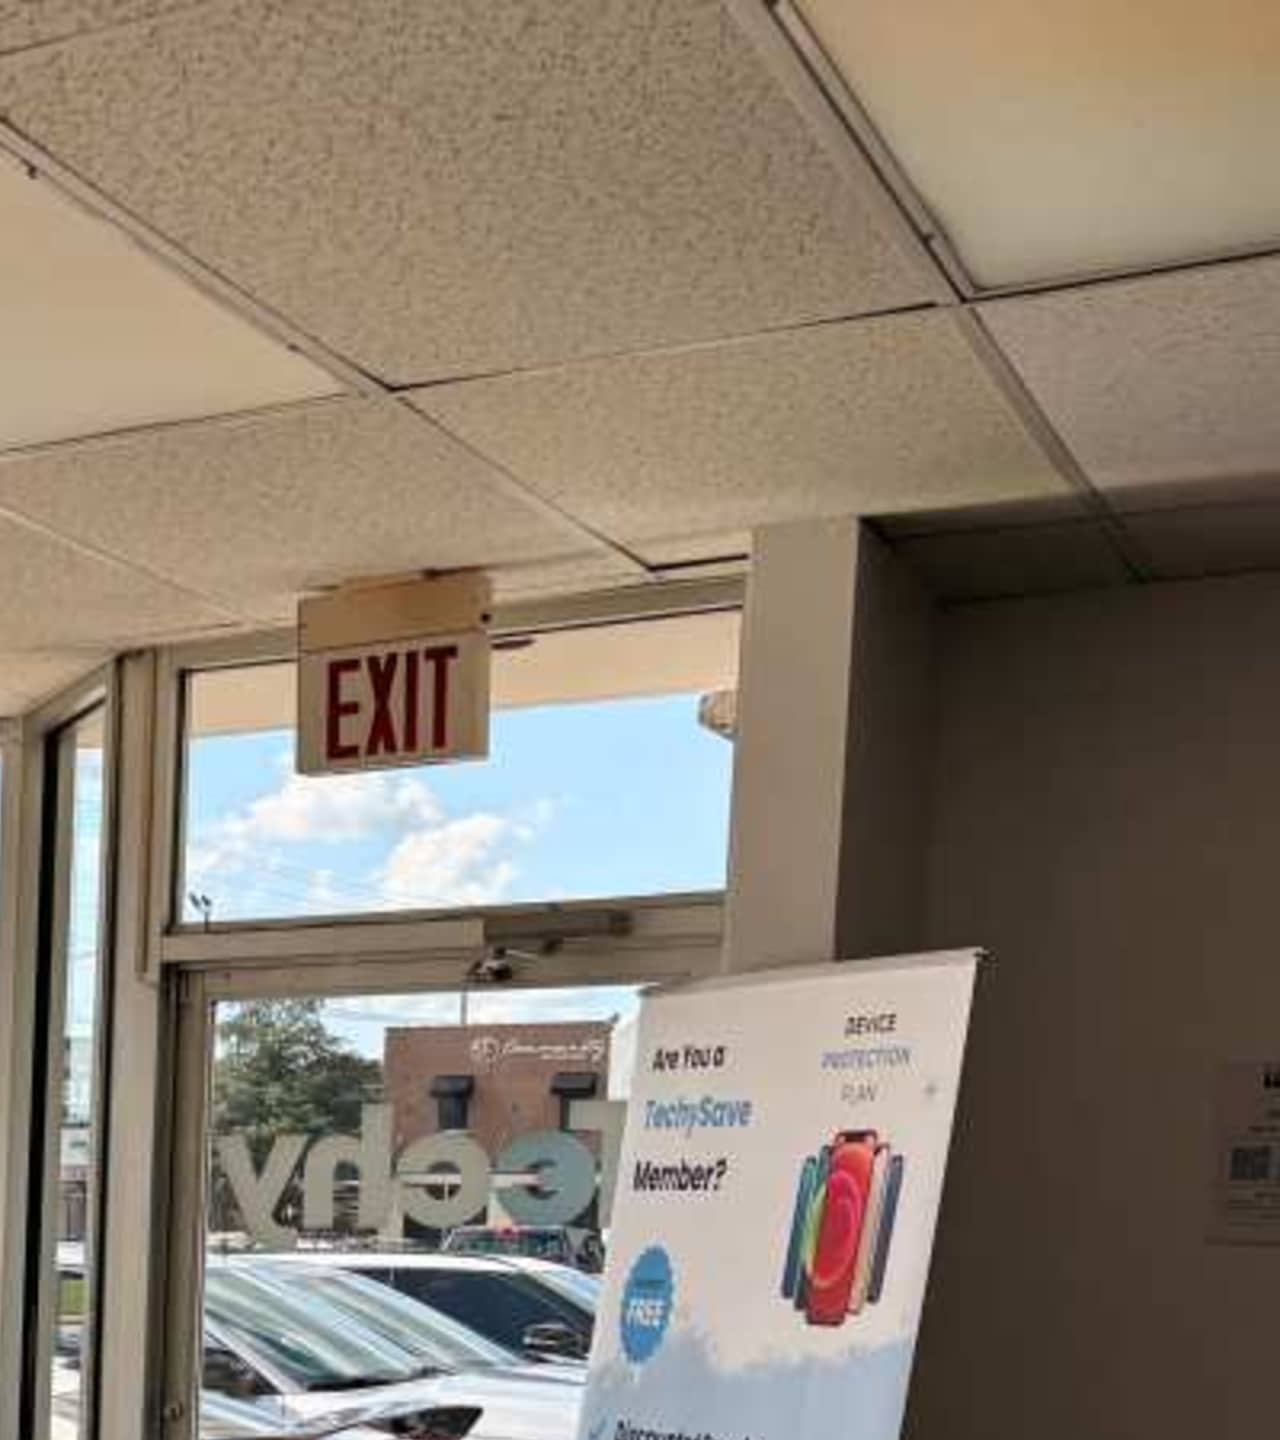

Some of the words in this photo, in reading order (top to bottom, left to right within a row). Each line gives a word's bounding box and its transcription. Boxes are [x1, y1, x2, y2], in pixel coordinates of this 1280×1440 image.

[326, 645, 458, 758] EXIT
[845, 1014, 896, 1036] DEVICE
[652, 1047, 679, 1071] Are
[683, 1045, 713, 1069] You
[821, 1047, 913, 1070] PROTECTION
[842, 1083, 878, 1102] PLAN
[644, 1097, 753, 1137] TechySave
[633, 1157, 728, 1191] Member?
[627, 1299, 664, 1327] FREE
